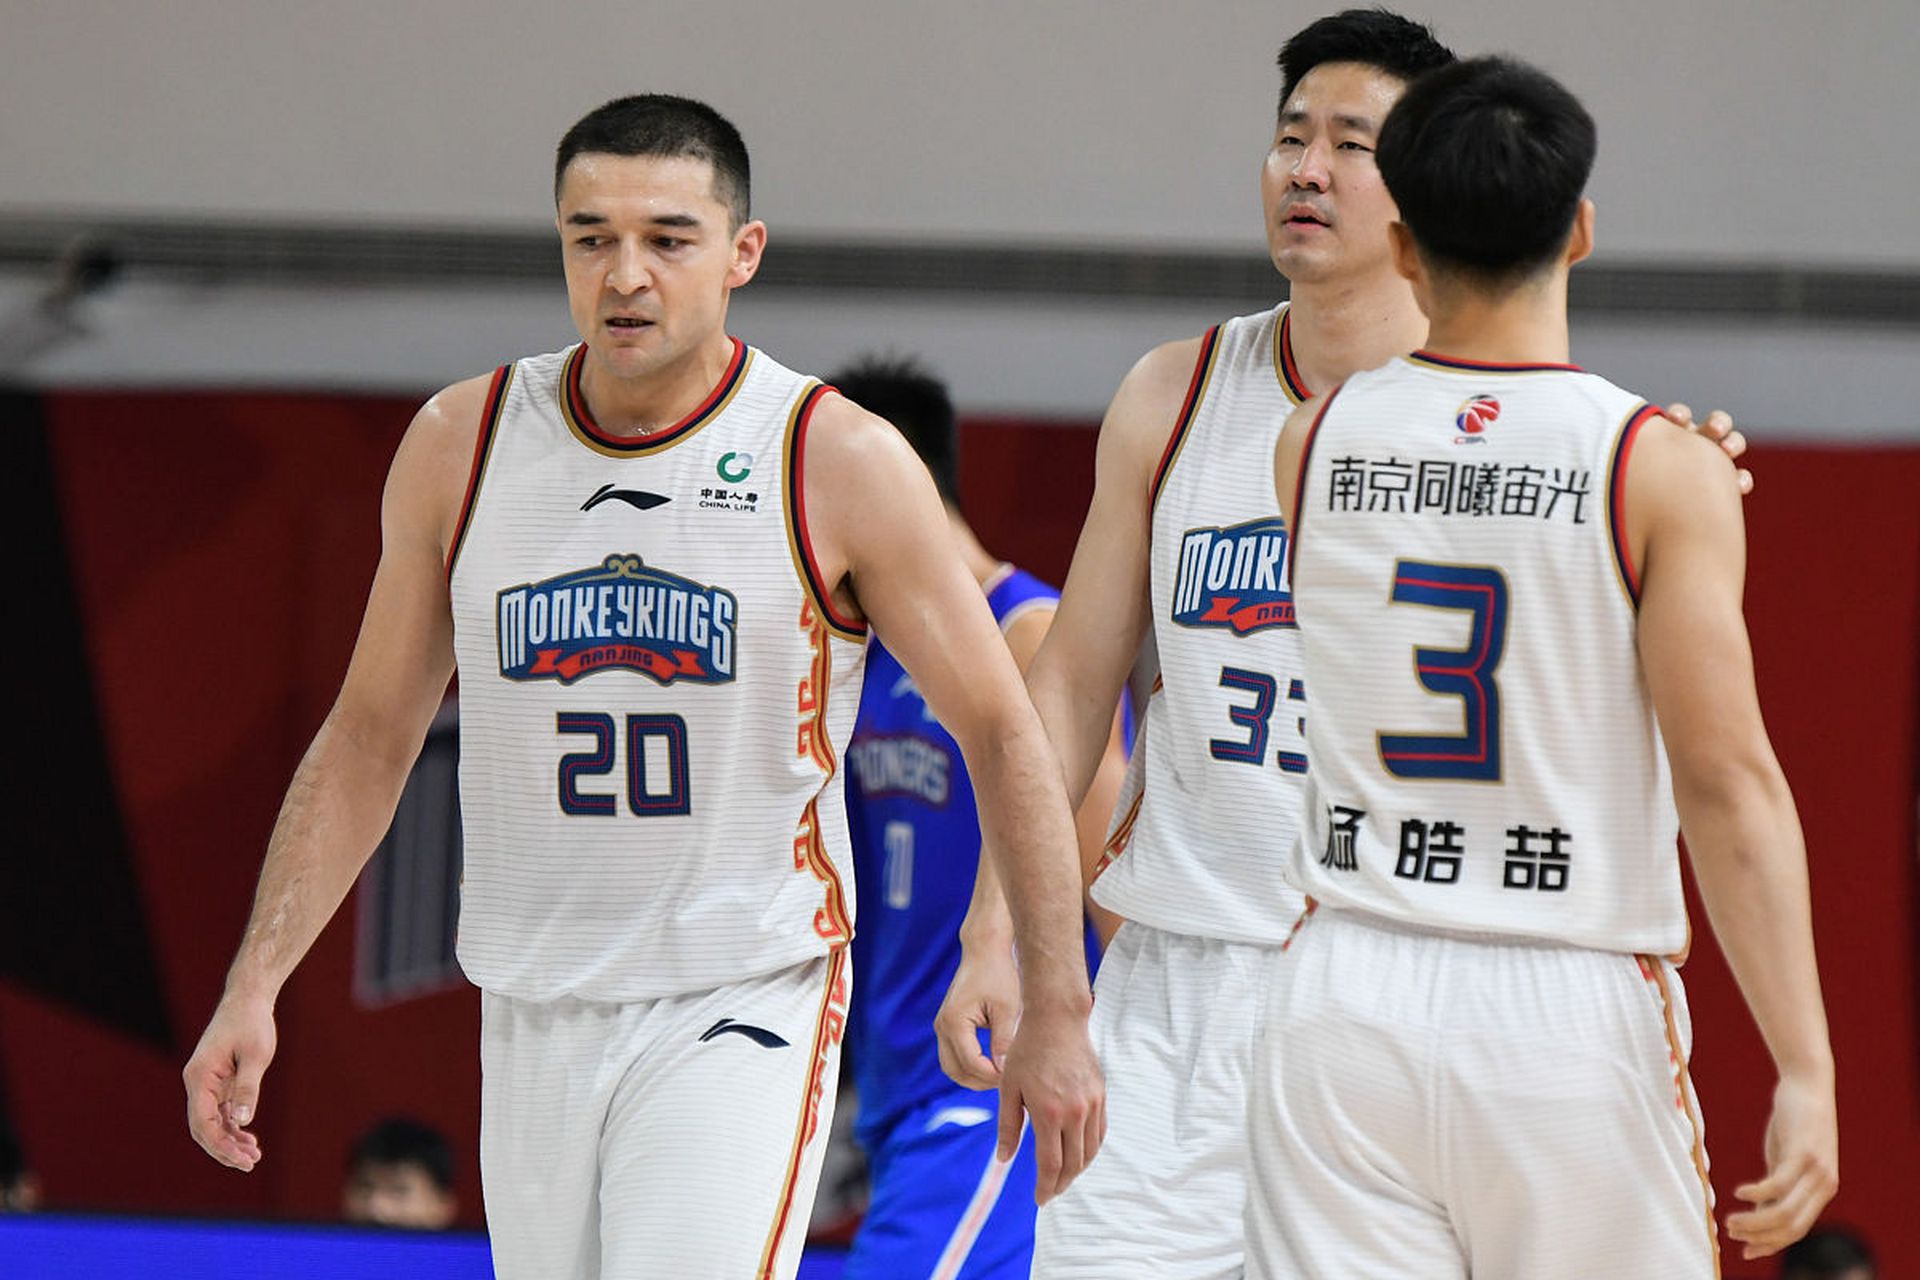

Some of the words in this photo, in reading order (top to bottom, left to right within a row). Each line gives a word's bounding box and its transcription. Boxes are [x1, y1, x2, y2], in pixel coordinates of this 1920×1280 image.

[699, 500, 731, 509] CHINA
[734, 503, 756, 512] LIFE
[1329, 456, 1591, 524] 南京同曦宙光
[500, 585, 735, 675] MONKEYKINGS
[580, 648, 653, 667] NANJING
[1376, 557, 1512, 786] 3
[556, 711, 692, 817] 20
